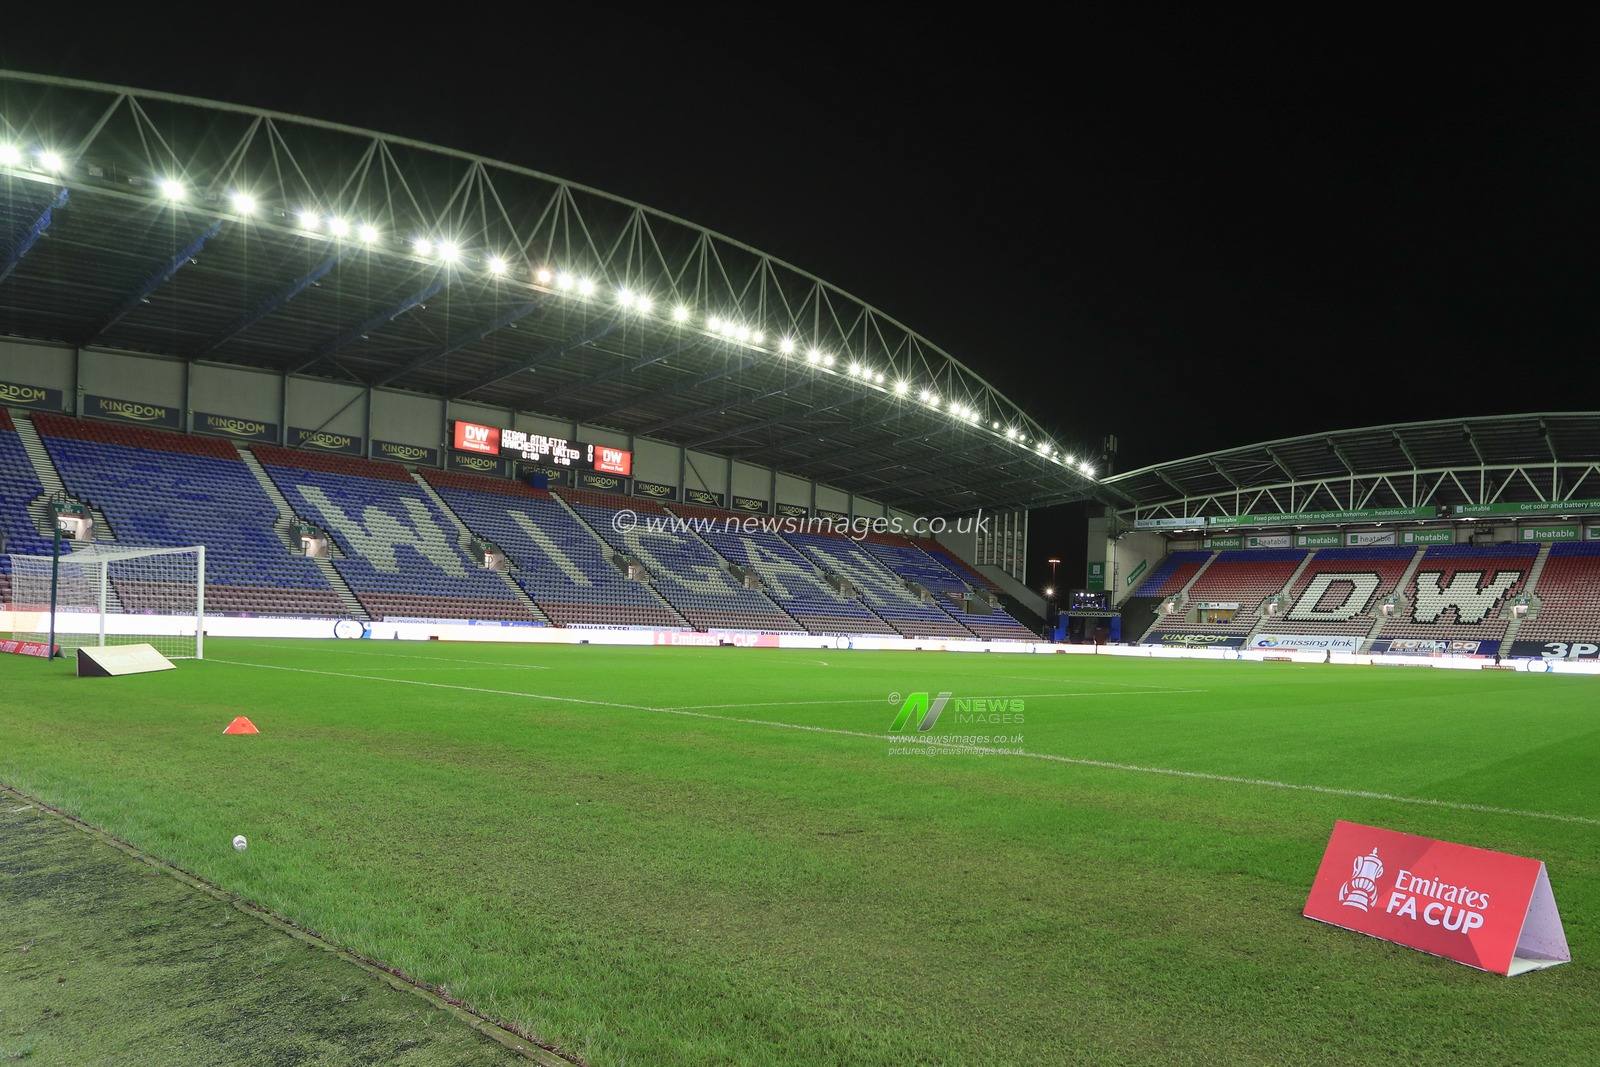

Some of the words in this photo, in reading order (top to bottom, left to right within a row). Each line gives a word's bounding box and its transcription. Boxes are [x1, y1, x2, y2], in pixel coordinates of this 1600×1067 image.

[100, 400, 165, 418] KINGDOM
[208, 416, 265, 433] KINGDOM
[300, 431, 351, 447] KINGDOM
[465, 425, 489, 442] DW
[531, 434, 568, 449] ATHLETIC
[381, 443, 428, 458] KINGDOM
[553, 447, 580, 460] UNITED
[588, 444, 594, 453] 0
[456, 455, 497, 469] KINGDOM
[587, 453, 593, 462] 0
[603, 450, 623, 464] DW
[583, 475, 618, 487] KINGDOM
[638, 482, 670, 494] KINGDOM
[736, 497, 763, 508] KINGDOM
[1465, 505, 1491, 513] heatable
[1564, 501, 1589, 509] battery
[779, 504, 805, 514] KINGDOM
[1216, 516, 1237, 524] heatable
[1320, 512, 1335, 520] quick
[1375, 508, 1416, 516] heatable.co.uk
[1307, 535, 1338, 545] heatable
[1360, 534, 1391, 544] heatable
[1415, 532, 1449, 542] heatable
[1536, 529, 1575, 539] heatable
[1212, 538, 1240, 547] heatable
[1258, 537, 1287, 546] heatable
[1284, 571, 1523, 623] DW
[672, 633, 716, 646] Emirates
[733, 634, 759, 647] CUP
[1161, 634, 1229, 642] KINGDOM
[1281, 639, 1329, 649] missing
[1331, 638, 1354, 648] link
[1393, 640, 1478, 650] TOMACO
[1541, 642, 1600, 659] 3P
[1395, 869, 1490, 910] Emirates
[1386, 891, 1417, 920] FA
[1423, 902, 1484, 935] CUP
